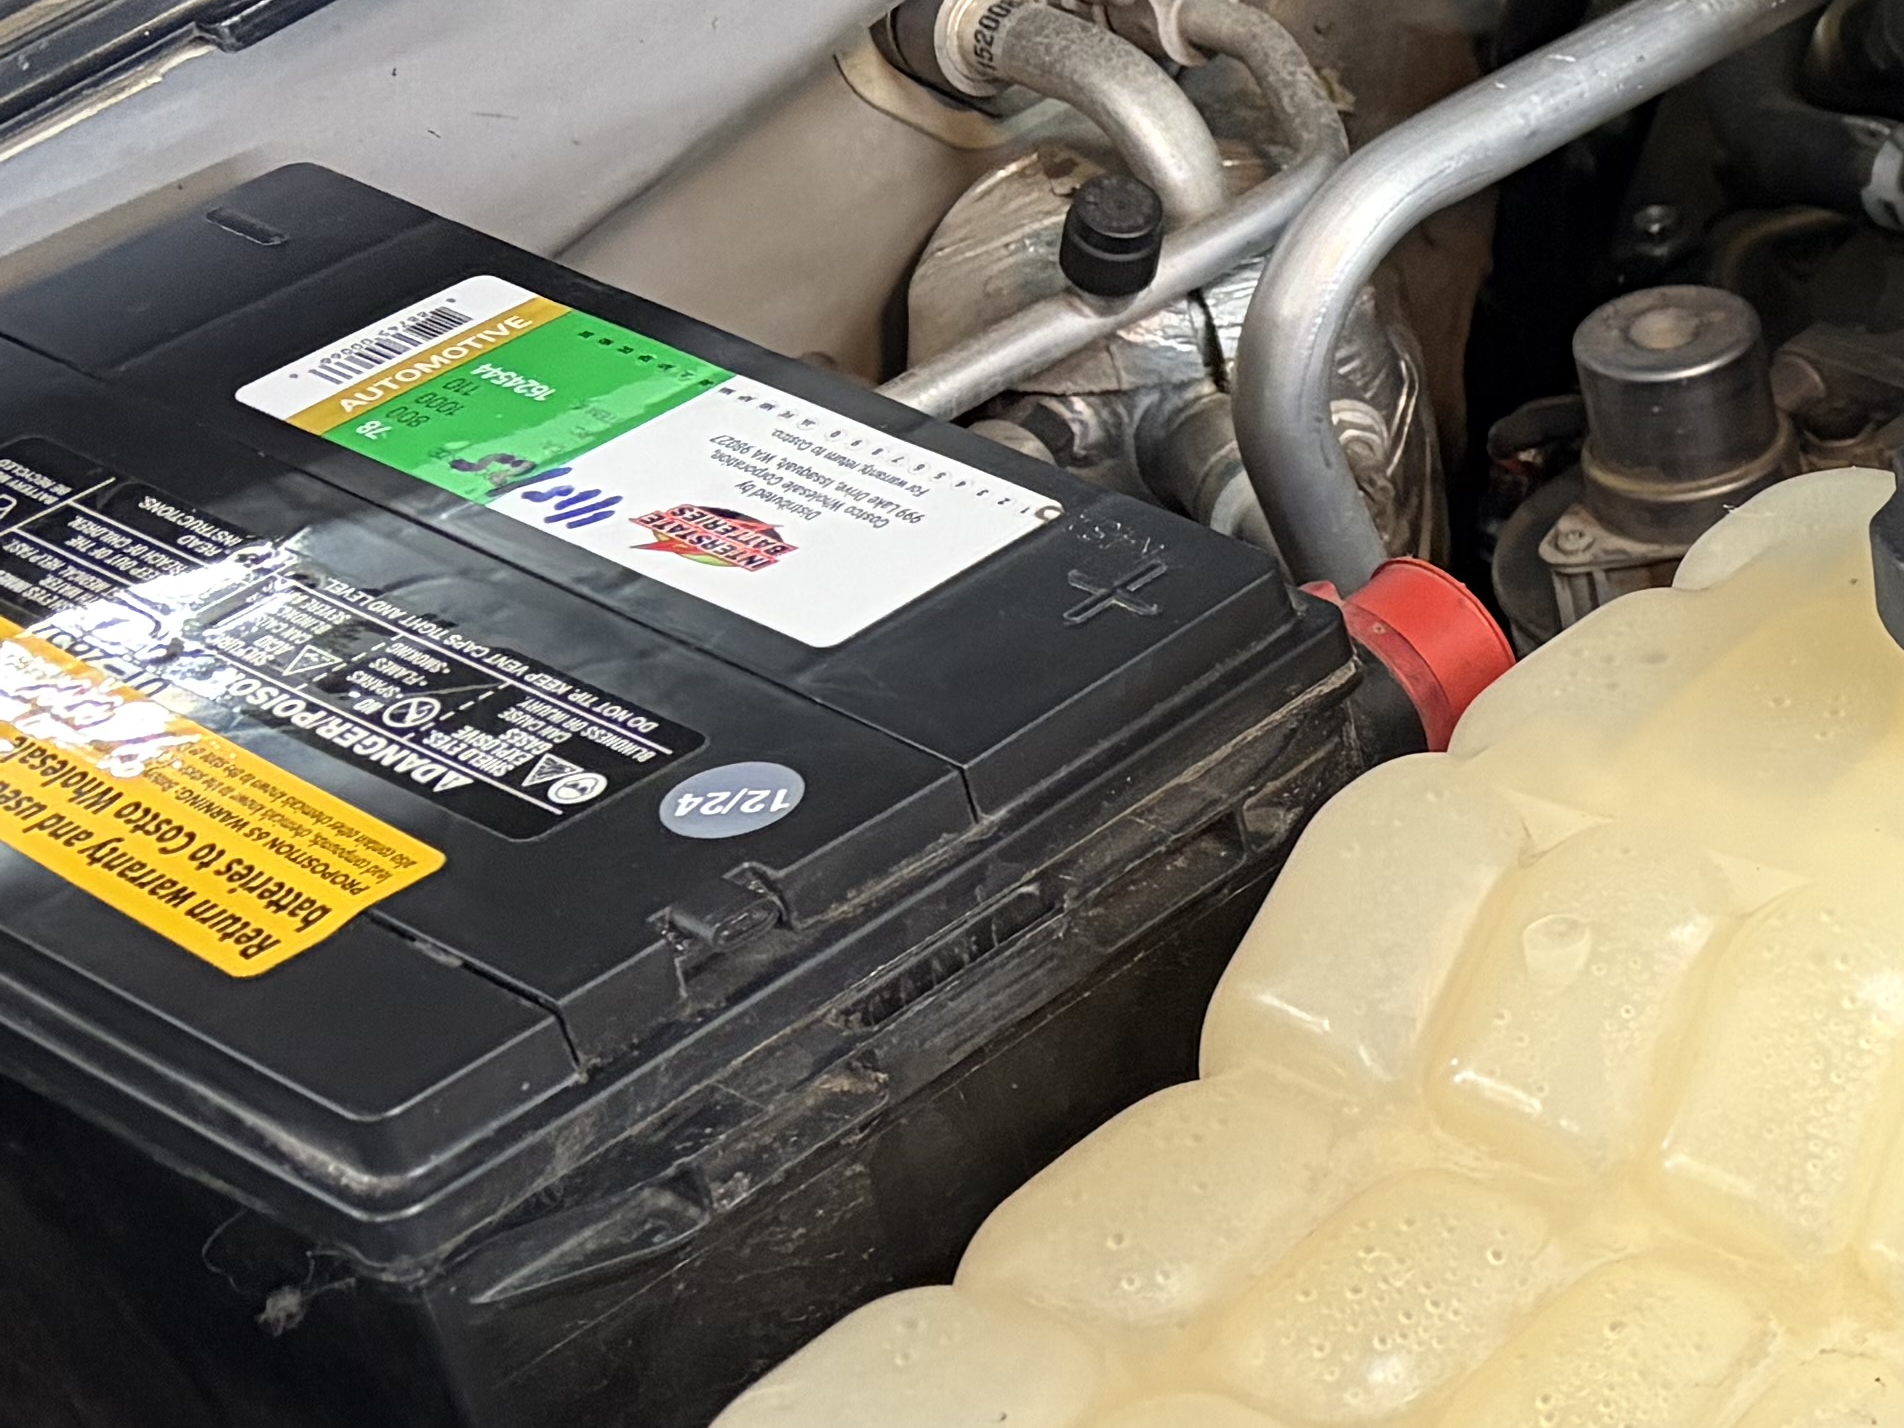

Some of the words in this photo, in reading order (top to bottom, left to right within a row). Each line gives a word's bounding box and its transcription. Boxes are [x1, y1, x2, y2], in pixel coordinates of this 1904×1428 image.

[340, 315, 531, 411] AUTOMOTIVE
[442, 377, 479, 396] 110
[470, 363, 555, 400] 1624544
[384, 405, 430, 427] 800
[413, 391, 464, 416] 1000
[355, 420, 392, 439] 78
[709, 434, 754, 454] 98027
[750, 448, 777, 464] WA
[823, 451, 860, 469] return
[734, 479, 756, 494] by
[781, 480, 845, 511] Wholesale
[904, 484, 930, 497] For
[747, 487, 821, 520] Distributed
[866, 495, 901, 514] Lake
[894, 508, 925, 523] 999
[138, 496, 241, 546] INSTRUCTIONS.
[843, 505, 889, 528] Costco
[64, 528, 94, 555] THE
[643, 512, 773, 569] INTERSTATE
[669, 507, 790, 557] BATTERIES
[93, 542, 111, 562] OF
[176, 534, 221, 556] READ
[110, 549, 132, 571] OUT
[322, 577, 374, 608] LEVEL.
[368, 600, 406, 619] AND
[400, 615, 449, 640] TIGHT
[252, 630, 294, 659] ACID
[443, 633, 489, 657] CAPS
[485, 653, 528, 675] VENT
[524, 672, 572, 694] KEEP
[353, 697, 383, 714] NO
[517, 696, 569, 723] INJURY.
[567, 688, 598, 707] TIP.
[497, 707, 545, 731] CAUSE
[592, 701, 633, 721] NOT
[537, 725, 571, 743] CAN
[562, 717, 588, 731] OR
[626, 716, 658, 732] DO
[422, 729, 467, 755] EYES.
[451, 725, 533, 765] EXPLOSIVE
[499, 728, 552, 754] GASES
[580, 725, 655, 762] BLINDNESS
[458, 748, 513, 776] SHIELD
[175, 786, 249, 832] WARNING:
[674, 787, 789, 816] 12/24
[23, 800, 91, 854] and
[113, 794, 196, 854] Costco
[242, 826, 271, 841] 65
[189, 842, 225, 870] to
[264, 837, 369, 895] PROPOSITION
[81, 831, 195, 907] warranty
[214, 858, 330, 931] batteries
[185, 899, 279, 959] Return
